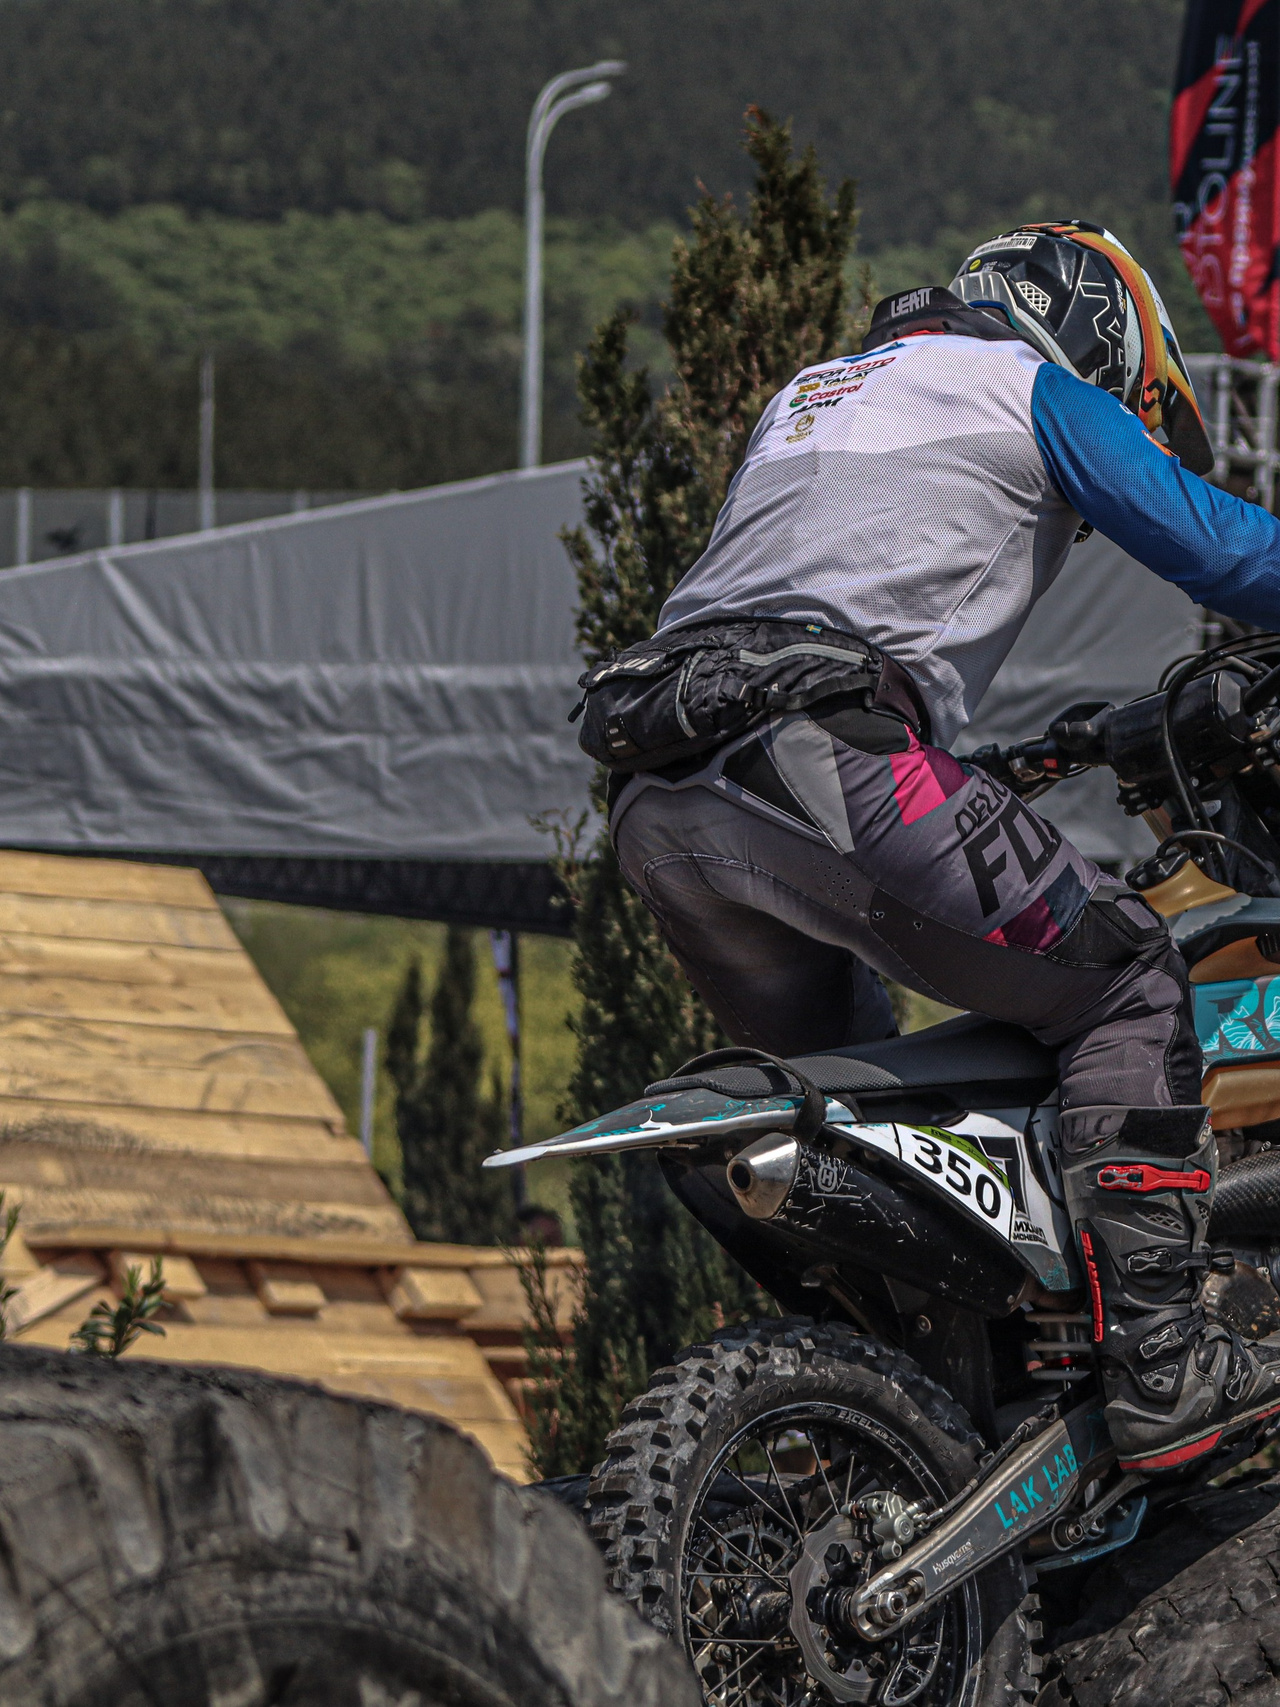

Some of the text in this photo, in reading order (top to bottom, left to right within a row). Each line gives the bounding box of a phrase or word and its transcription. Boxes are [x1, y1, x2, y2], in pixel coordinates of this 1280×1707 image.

[890, 287, 934, 318] LEATT
[847, 357, 897, 374] TOTO
[808, 382, 864, 402] Castrol
[911, 1133, 1002, 1220] 350
[837, 1409, 873, 1430] EXCEL
[994, 1443, 1078, 1530] LAK LAB
